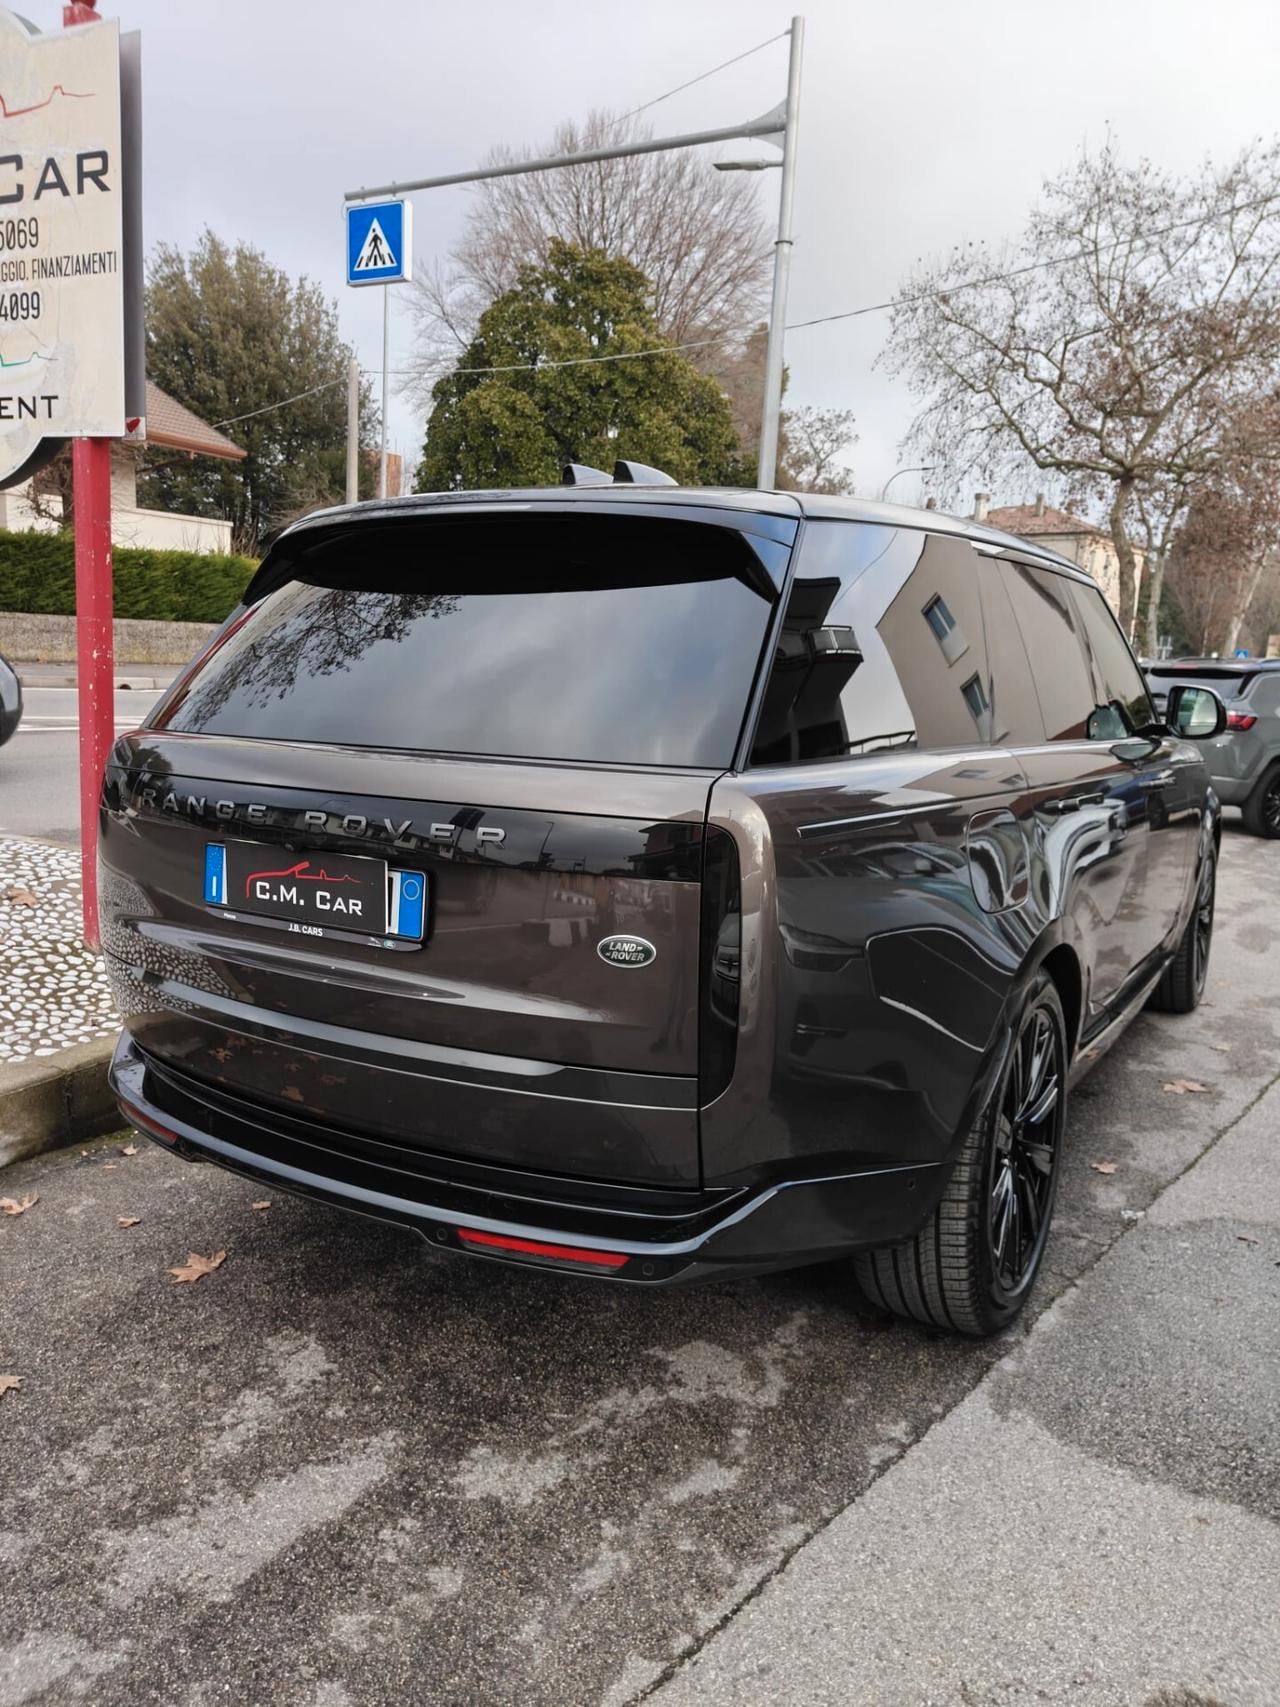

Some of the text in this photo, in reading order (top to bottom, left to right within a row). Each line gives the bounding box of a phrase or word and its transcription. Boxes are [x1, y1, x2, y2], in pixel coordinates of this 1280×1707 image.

[32, 251, 117, 280] FINANZIAMENTI
[0, 291, 40, 321] 4099
[142, 788, 505, 849] RANGE ROVER
[256, 881, 305, 906] C.M.
[302, 925, 323, 937] CARS
[610, 951, 645, 961] ROVER
